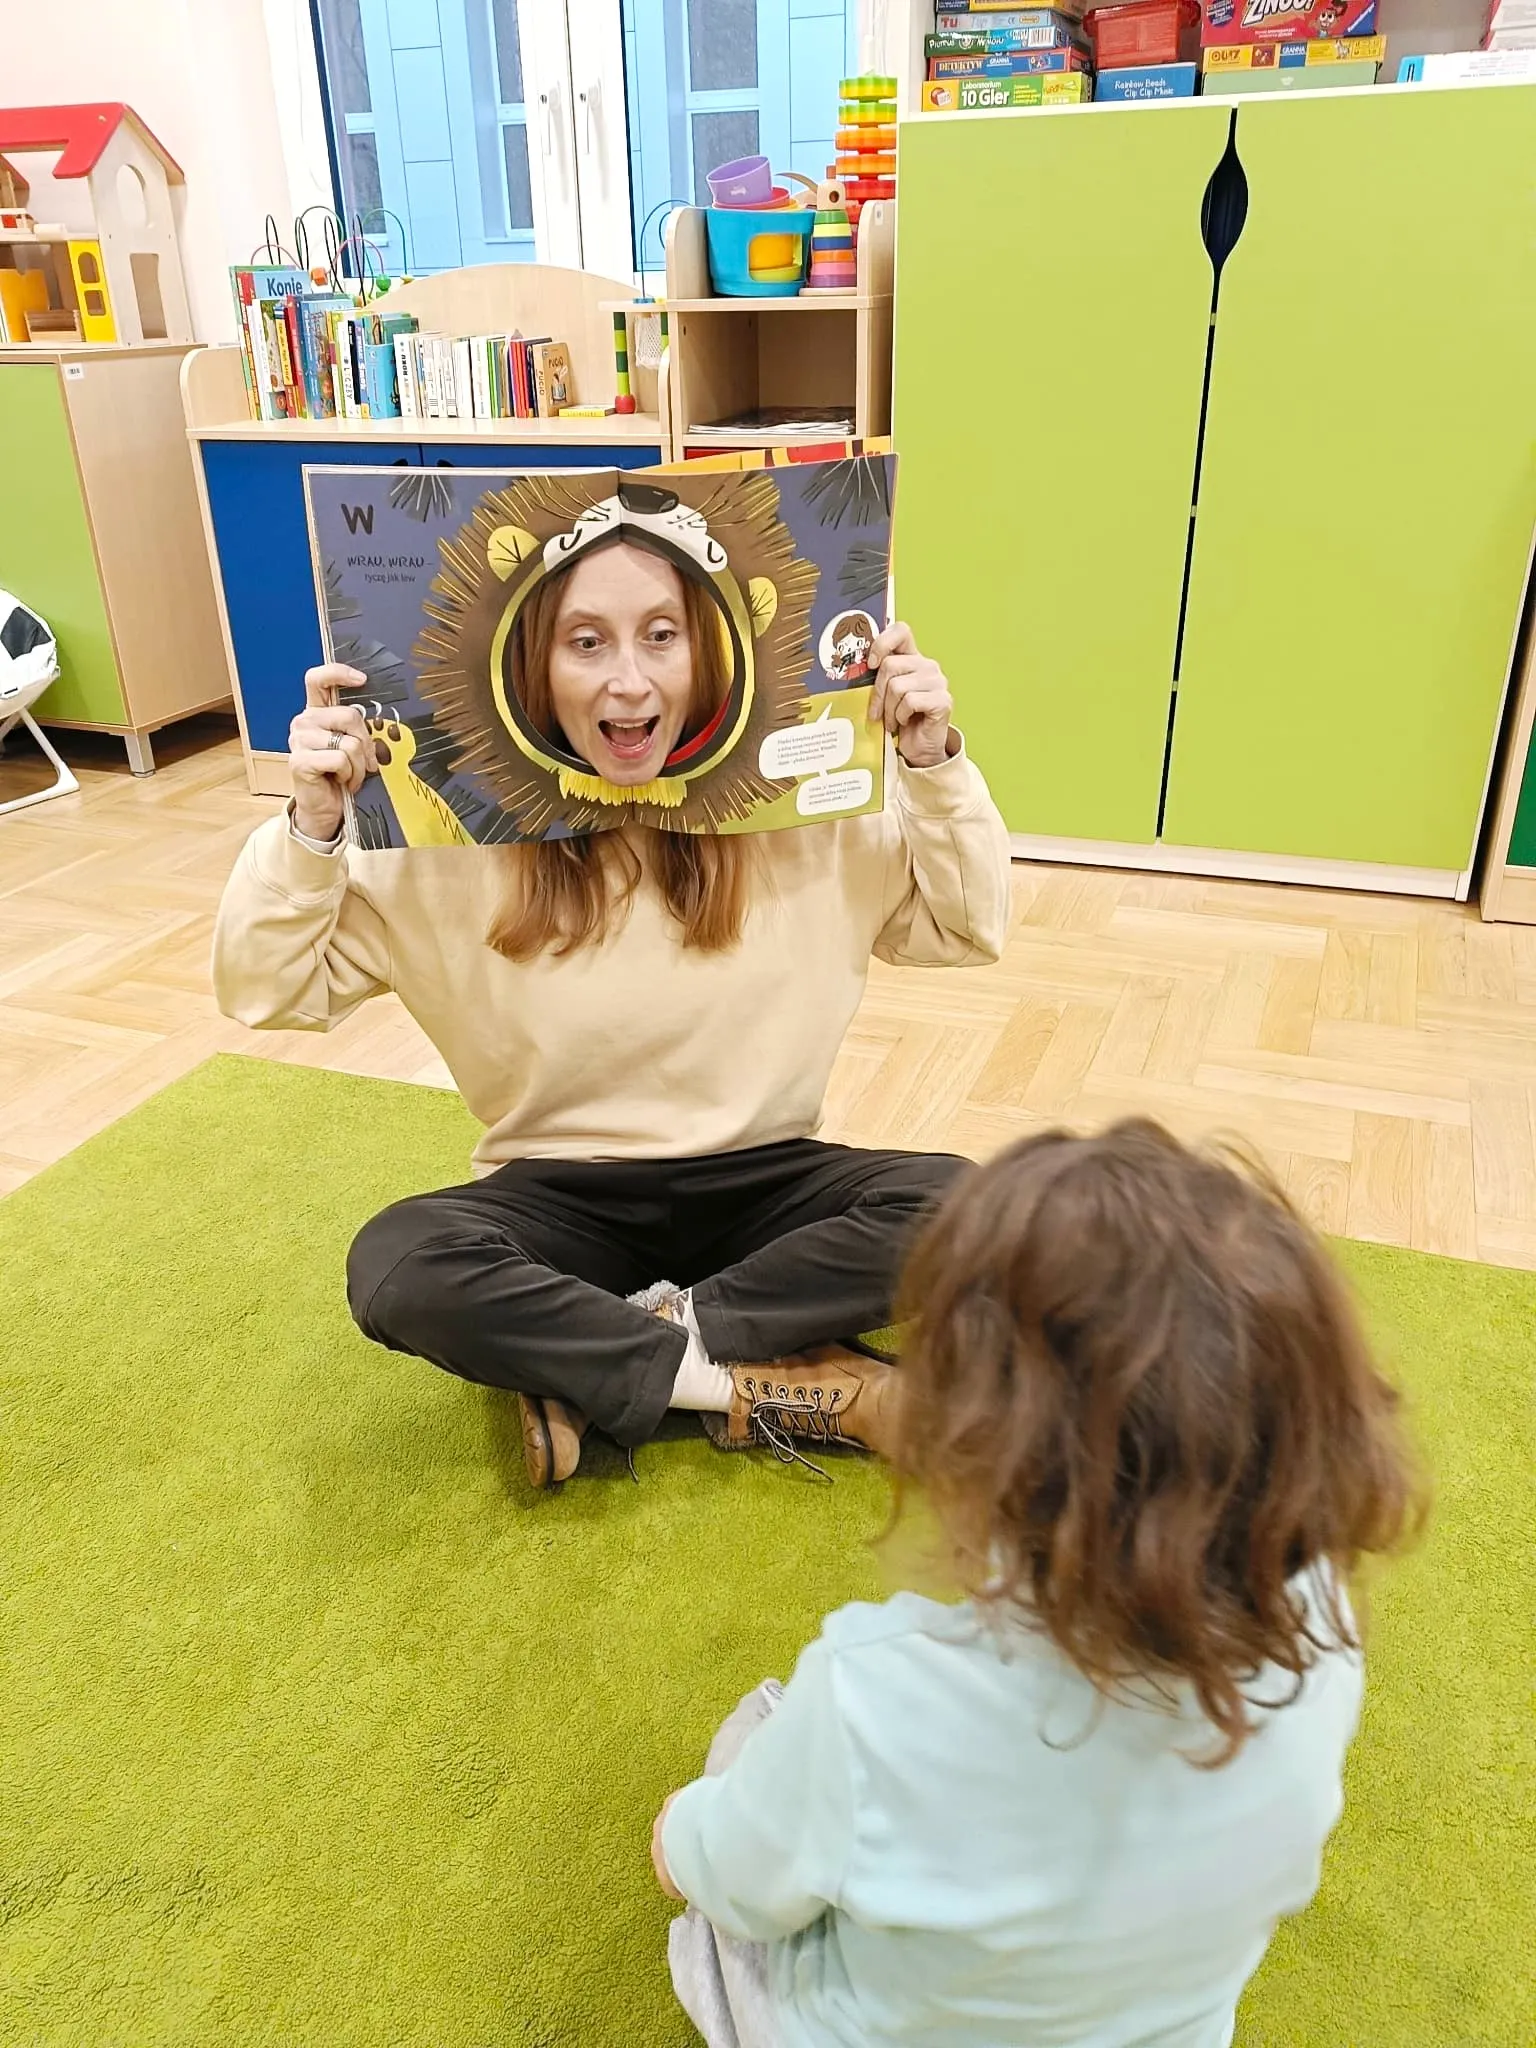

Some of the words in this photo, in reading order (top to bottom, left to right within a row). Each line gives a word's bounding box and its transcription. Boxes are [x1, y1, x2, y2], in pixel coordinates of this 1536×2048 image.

[1211, 49, 1241, 61] QUIZ
[962, 81, 1002, 90] Laboratorium
[1115, 80, 1144, 89] Rainbow
[1145, 78, 1166, 87] Beads
[962, 90, 977, 106] 10
[979, 88, 1010, 106] Gler
[1154, 86, 1174, 95] Music
[267, 276, 303, 297] Konie
[341, 503, 374, 535] W
[388, 555, 425, 569] WRAU
